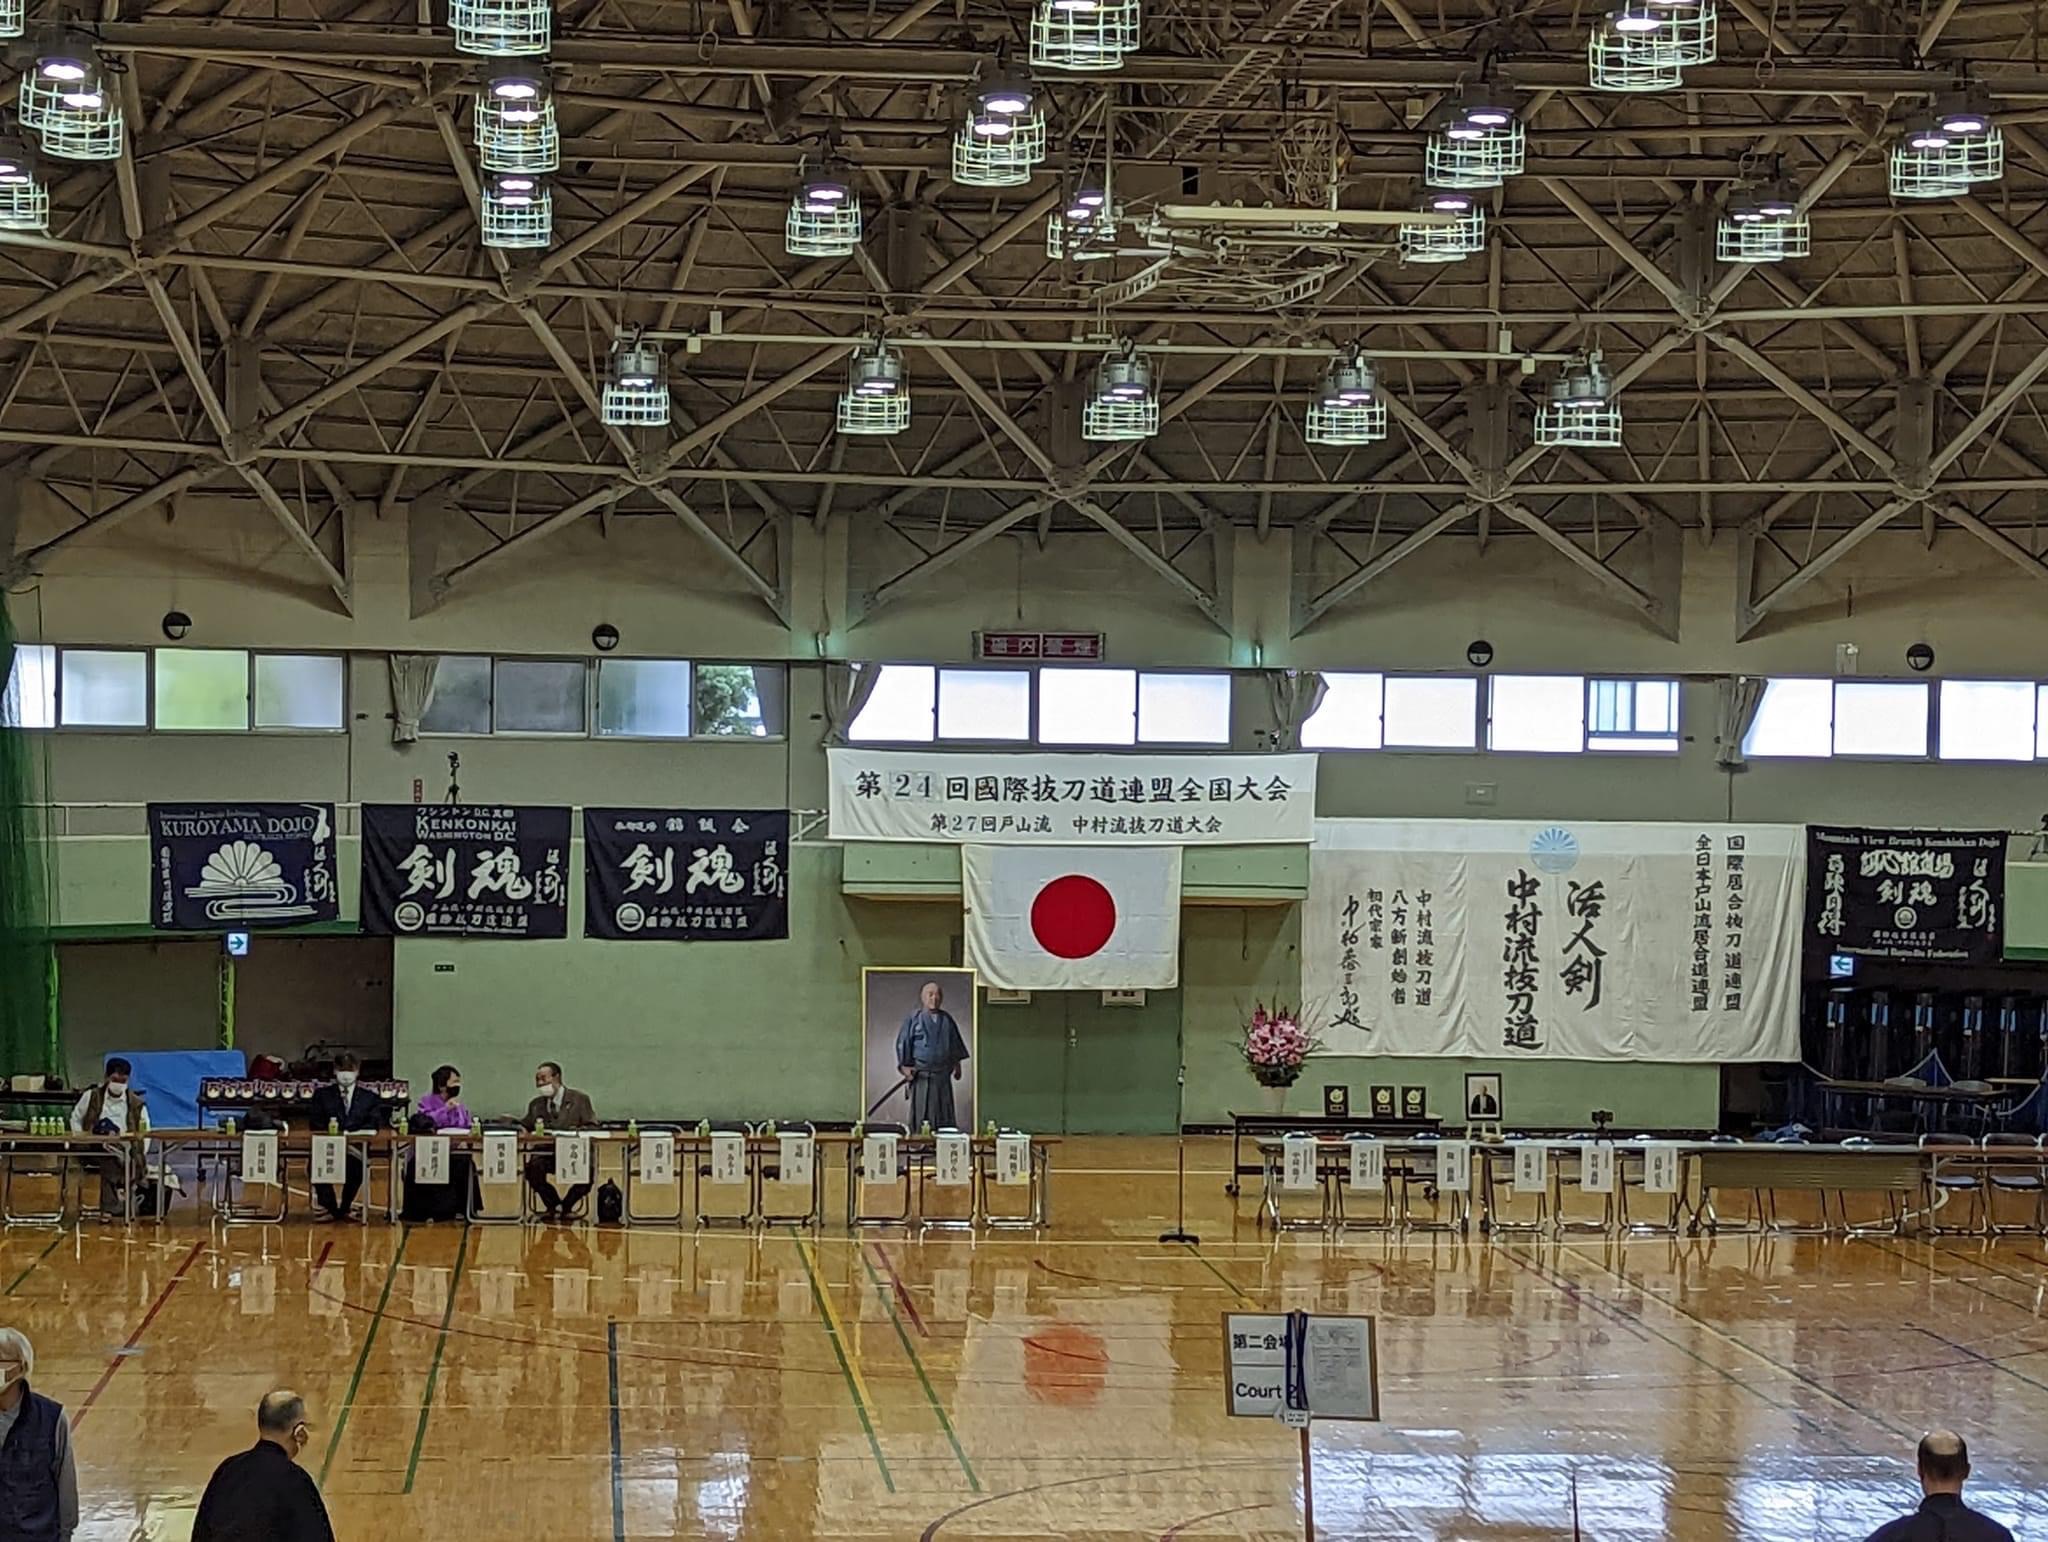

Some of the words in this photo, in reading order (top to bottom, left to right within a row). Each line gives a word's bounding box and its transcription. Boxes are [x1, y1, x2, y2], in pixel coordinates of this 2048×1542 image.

[160, 817, 262, 836] KUROYAMA
[267, 816, 315, 833] DOJO
[416, 816, 517, 831] KENKONKAI
[1072, 815, 1223, 835] 中村流抜刀道大会
[1503, 869, 1544, 1050] 中村流抜刀道
[1233, 1333, 1292, 1350] 第二会
[1236, 1383, 1282, 1399] Court
